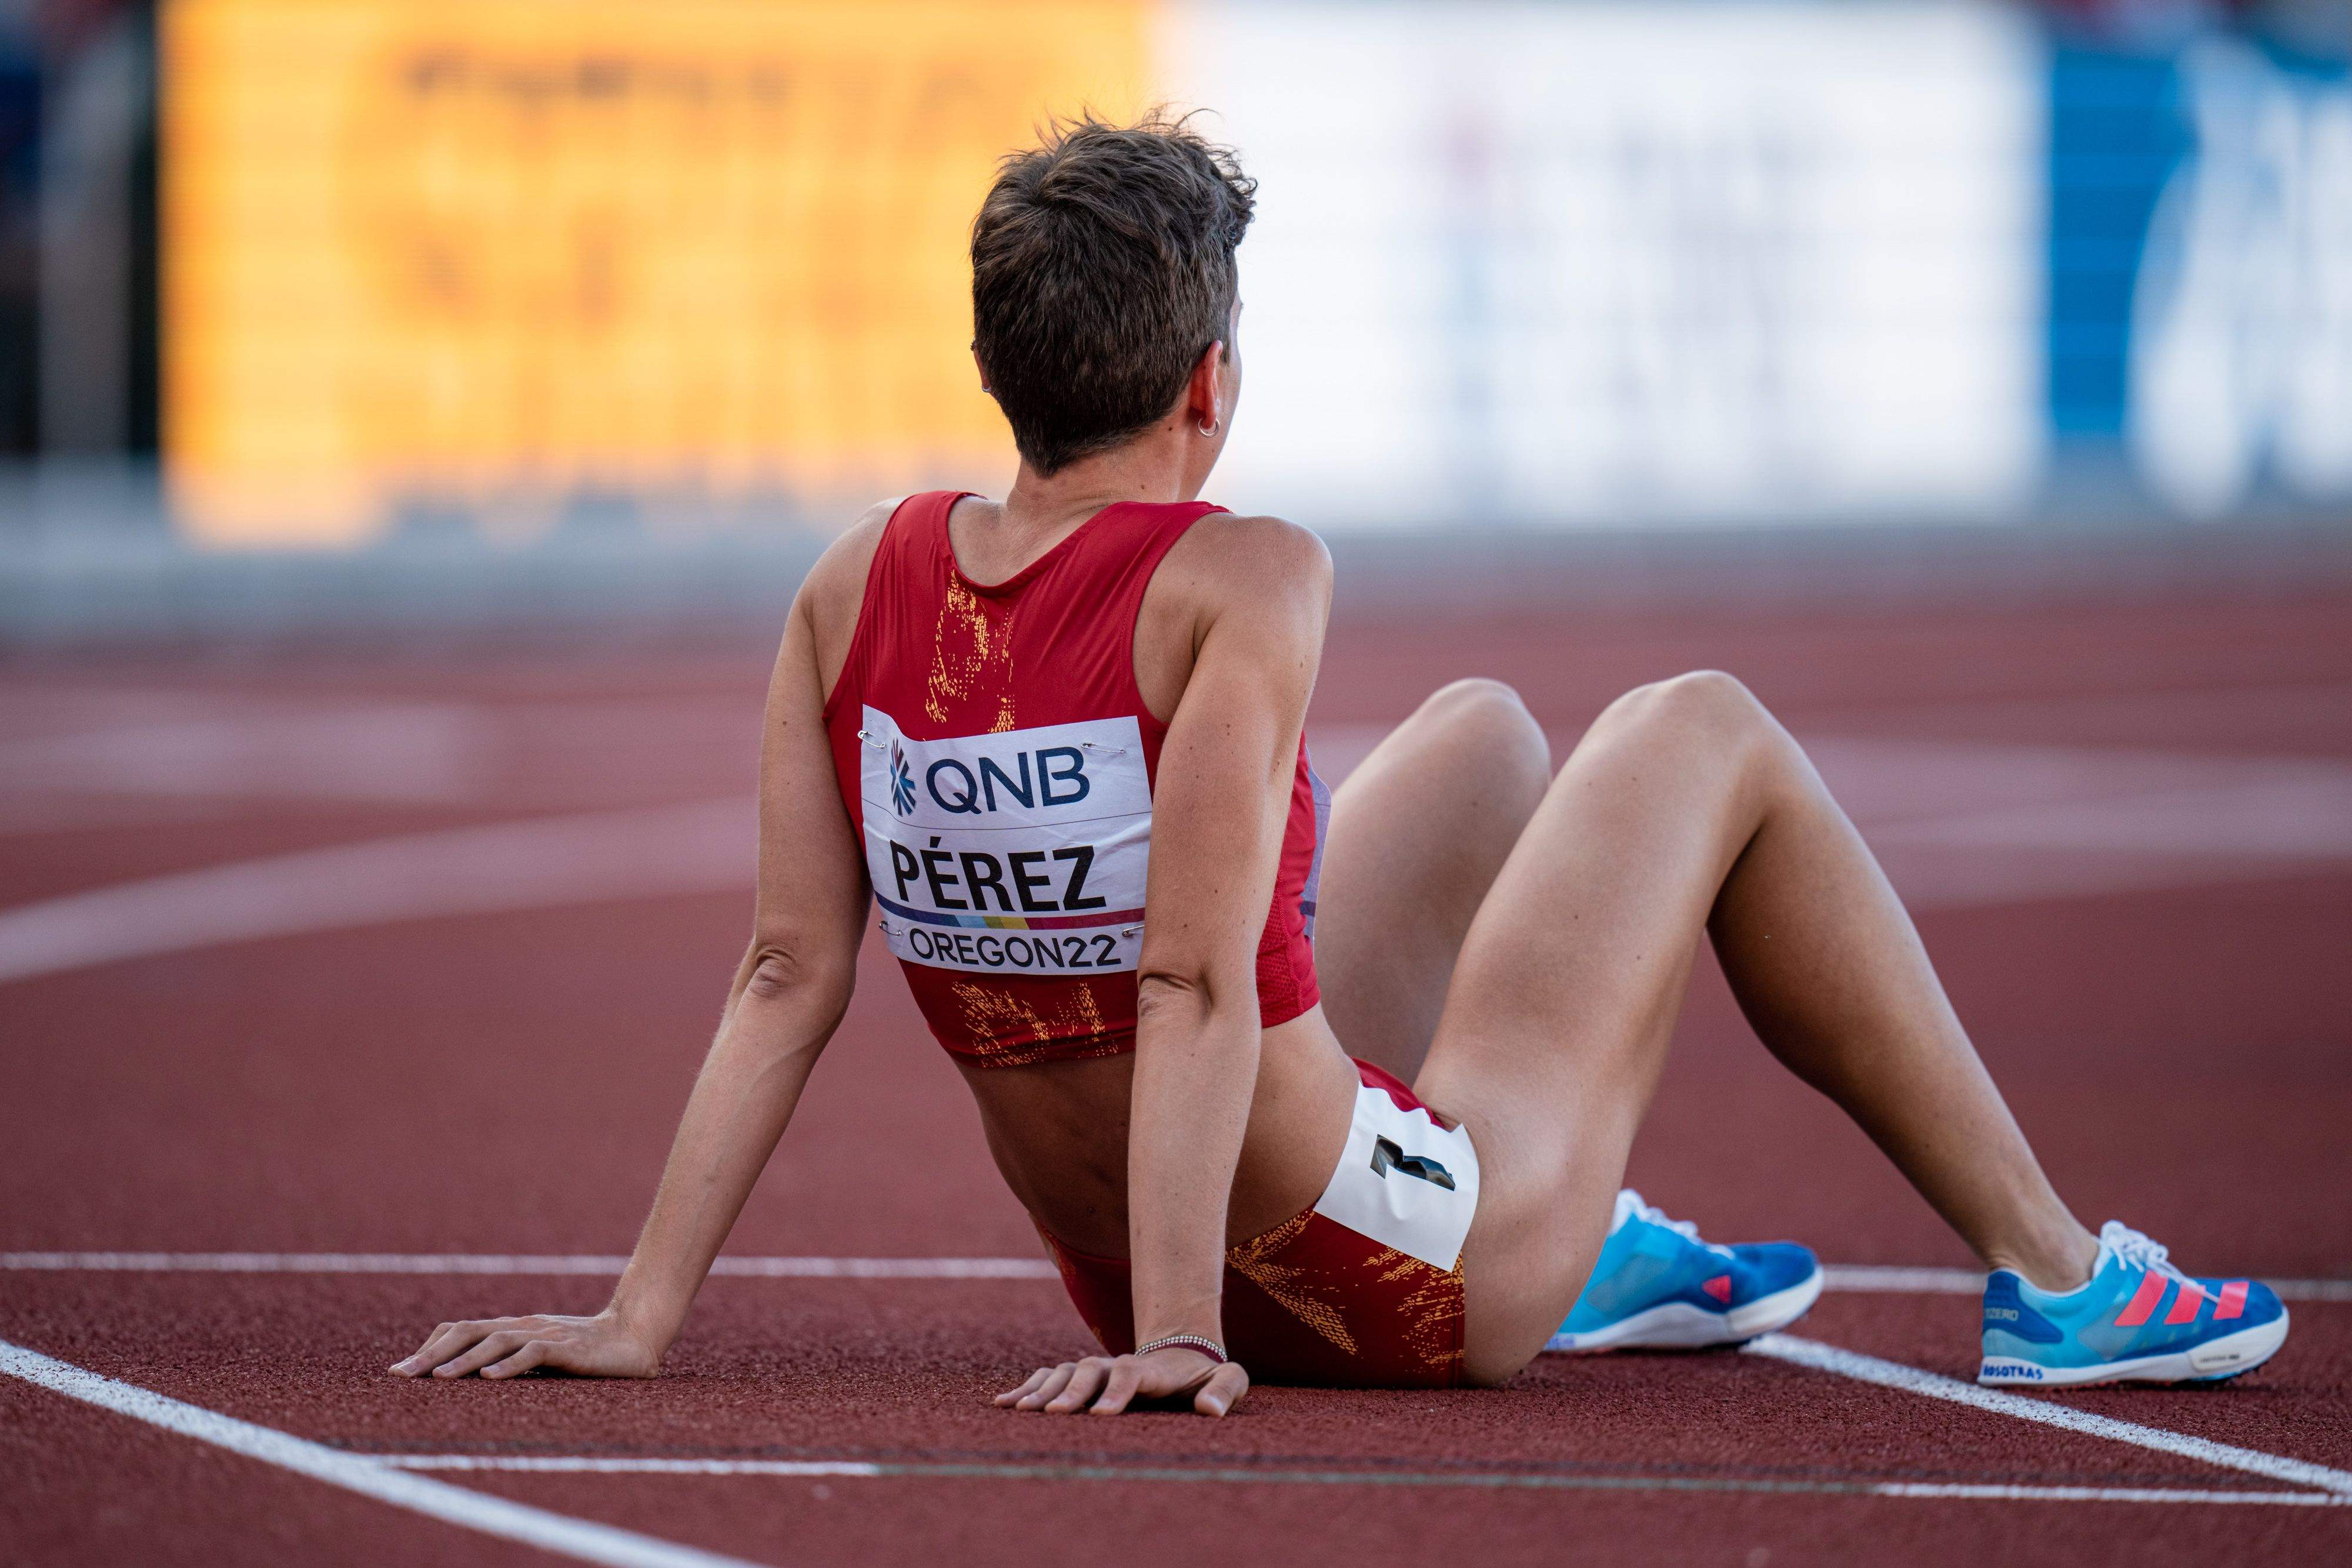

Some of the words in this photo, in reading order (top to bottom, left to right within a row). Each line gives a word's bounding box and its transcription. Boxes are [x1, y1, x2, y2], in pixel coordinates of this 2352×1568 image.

[926, 747, 1090, 814] QNB
[890, 836, 1107, 912] PÉREZ
[910, 928, 1122, 968] OREGON22
